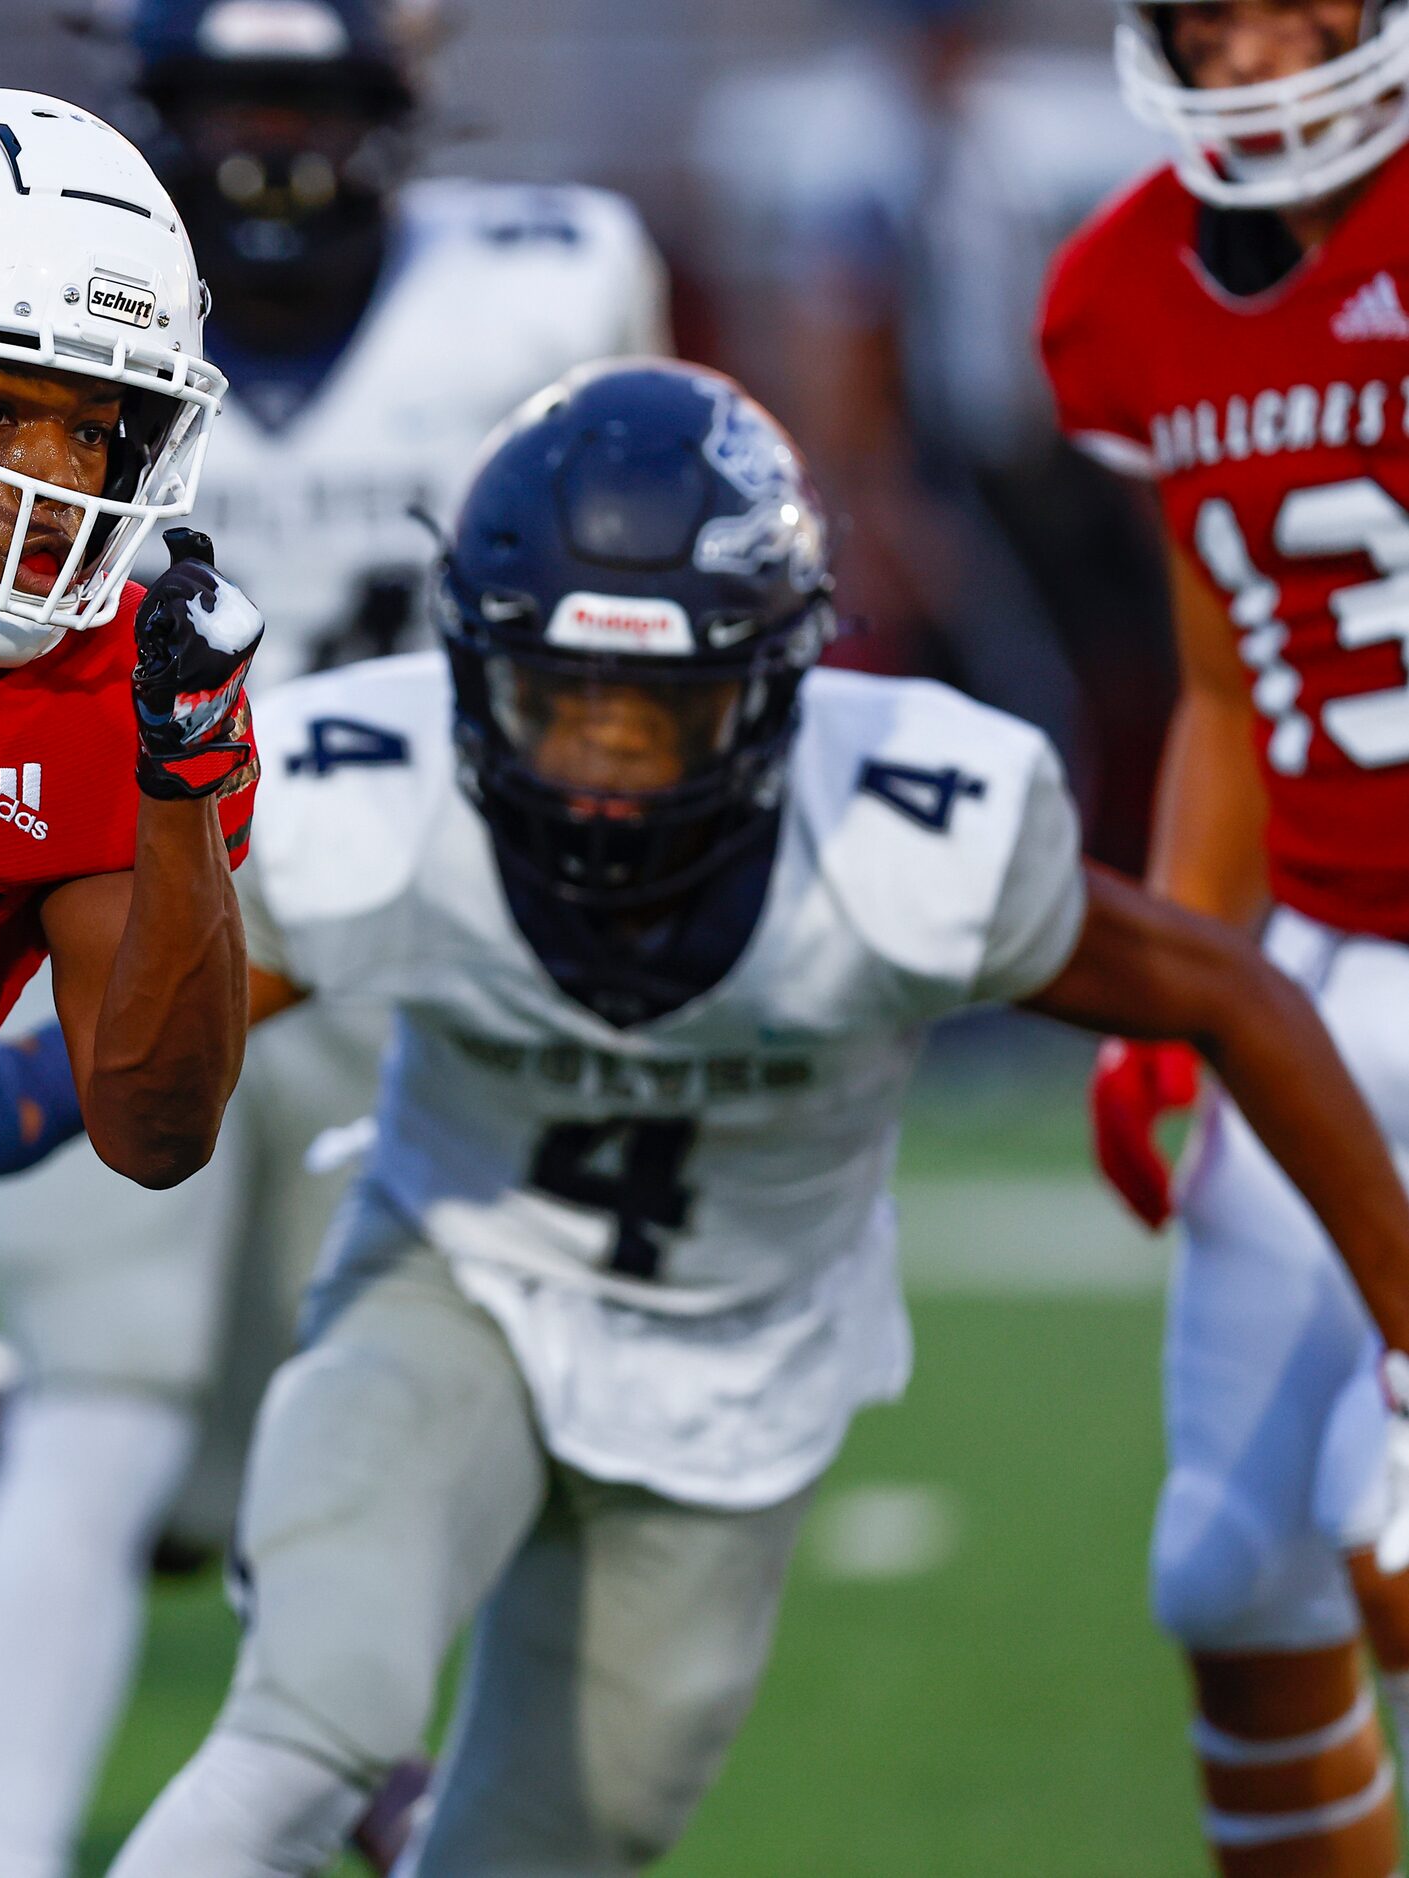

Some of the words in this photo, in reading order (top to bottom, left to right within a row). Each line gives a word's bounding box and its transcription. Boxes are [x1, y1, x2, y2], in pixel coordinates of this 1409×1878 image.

[91, 290, 152, 319] schutt
[1150, 374, 1409, 475] HILLCRES
[284, 717, 410, 779] 4
[856, 759, 988, 834] 4
[530, 1113, 702, 1278] 4
